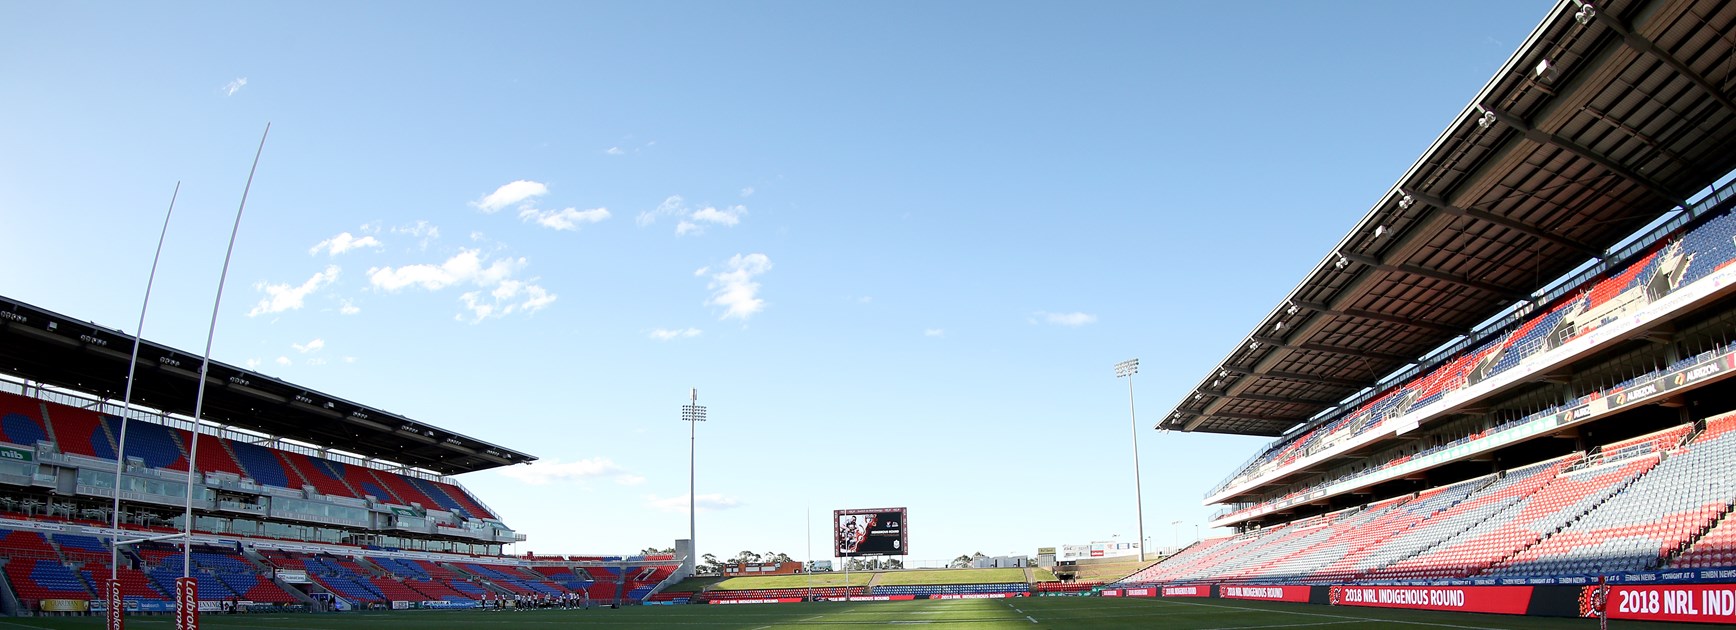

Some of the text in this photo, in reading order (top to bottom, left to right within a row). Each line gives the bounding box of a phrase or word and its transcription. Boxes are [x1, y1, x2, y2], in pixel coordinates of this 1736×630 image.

[1, 450, 24, 460] nib
[1640, 573, 1656, 581] NEWS
[1719, 570, 1736, 578] NEWS
[1345, 588, 1464, 607] 2018 NRL INDIGENOUS ROUND
[1619, 590, 1736, 616] 2018 NRL IND
